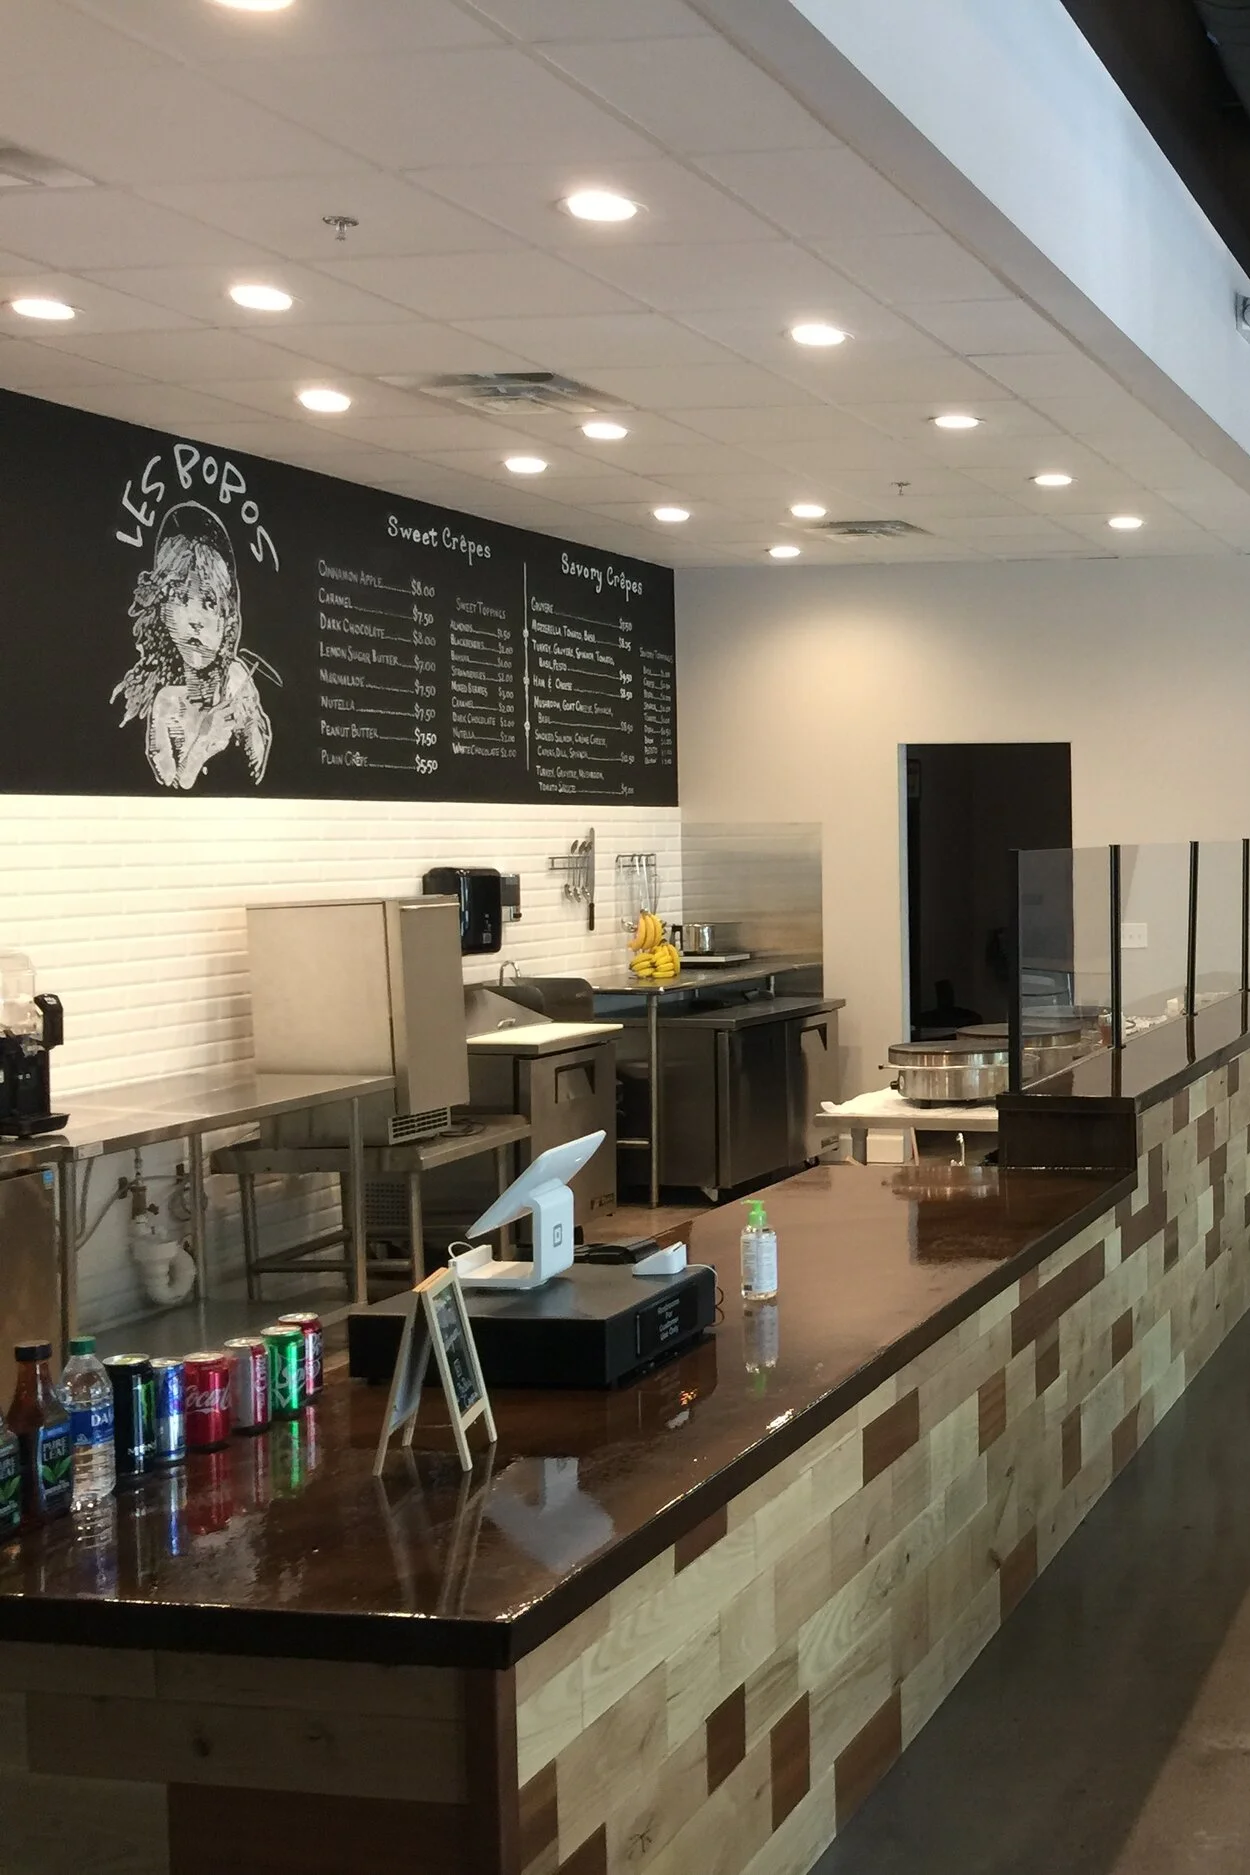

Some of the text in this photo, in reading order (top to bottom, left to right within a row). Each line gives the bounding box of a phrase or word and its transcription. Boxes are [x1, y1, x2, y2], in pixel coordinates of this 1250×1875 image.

[115, 443, 279, 573] LES BOBOS
[387, 515, 491, 566] Sweet Crêpes
[561, 552, 643, 602] Savory Crêpes
[412, 604, 434, 626] $7.50
[43, 1436, 67, 1452] PURE
[43, 1445, 66, 1462] LEAF
